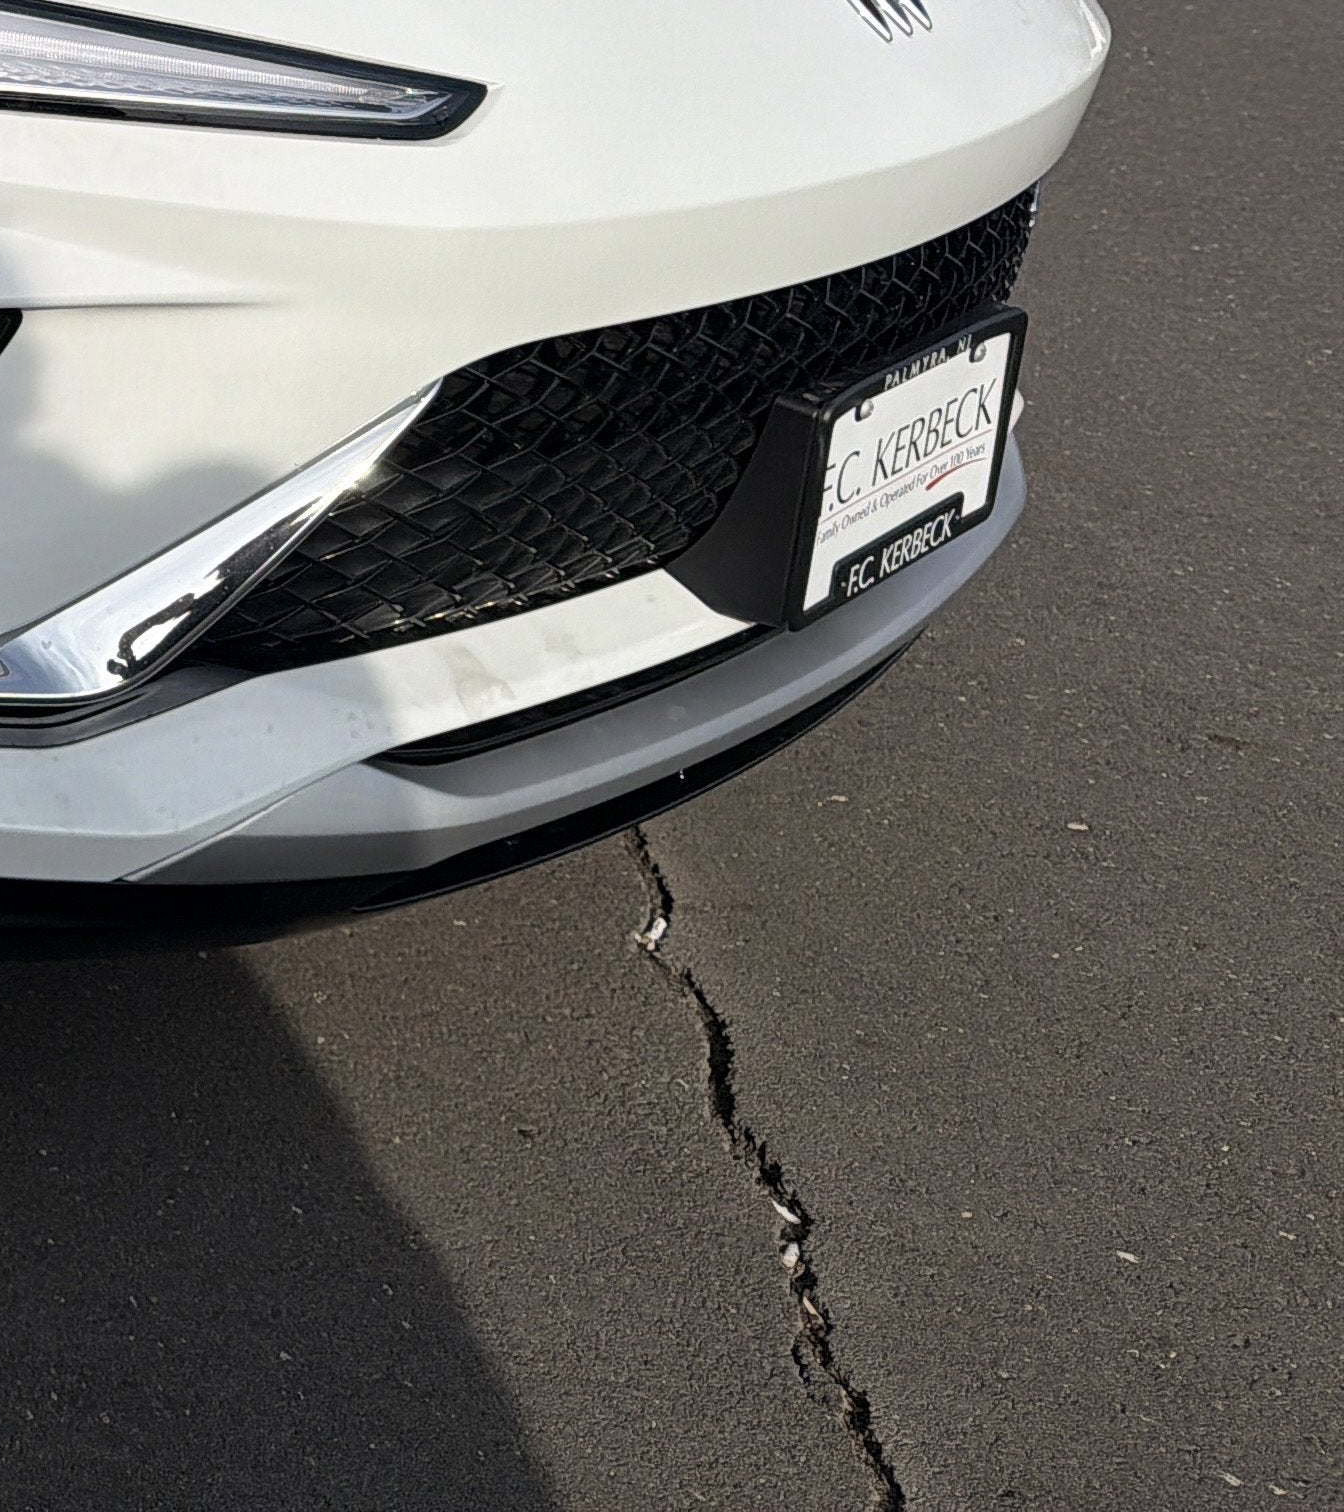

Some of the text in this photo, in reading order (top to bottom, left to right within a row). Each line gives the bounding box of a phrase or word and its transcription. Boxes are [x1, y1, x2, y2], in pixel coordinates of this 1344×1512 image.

[884, 347, 950, 391] PALMYRA,
[871, 377, 997, 487] KERBECK
[842, 501, 871, 530] Owned
[880, 475, 916, 509] Operated
[916, 471, 929, 488] For
[929, 461, 949, 480] Over
[846, 508, 956, 597] F.C. KERBECK
